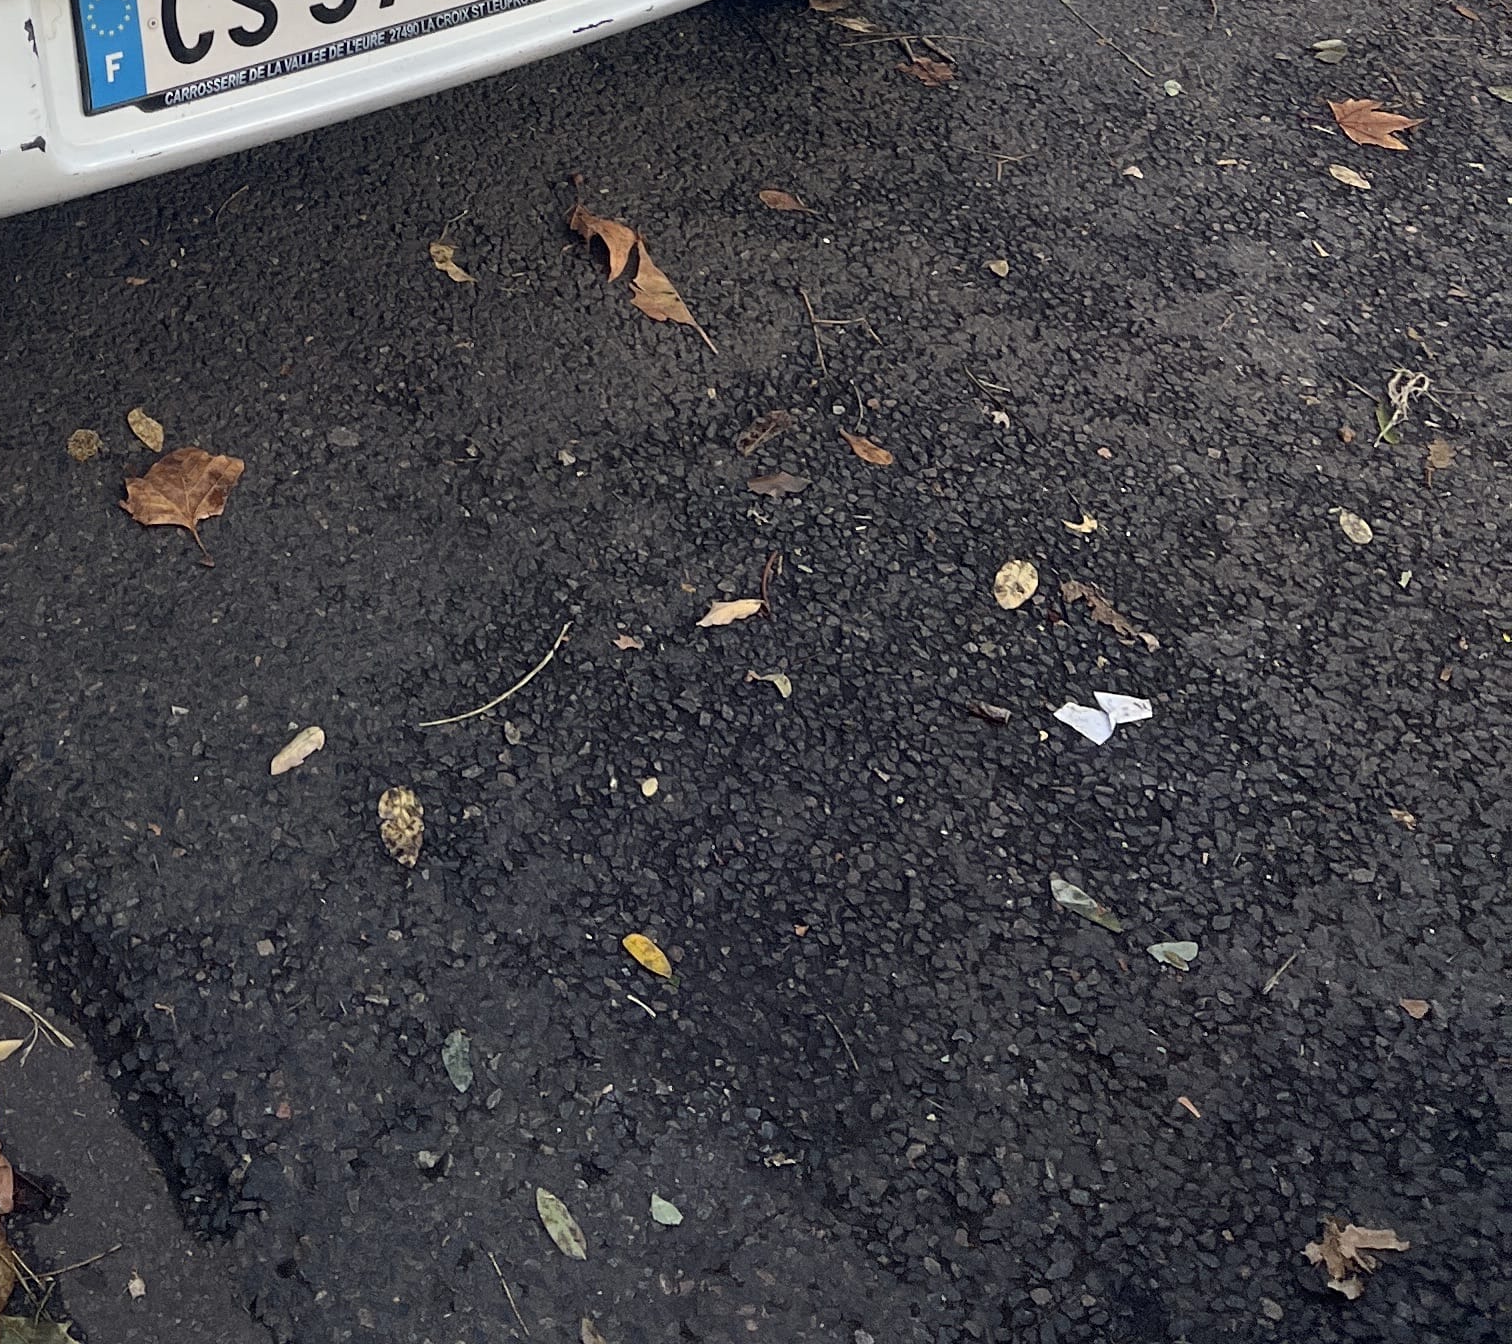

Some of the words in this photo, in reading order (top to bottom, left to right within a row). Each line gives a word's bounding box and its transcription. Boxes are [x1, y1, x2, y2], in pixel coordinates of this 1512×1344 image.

[105, 52, 123, 83] F
[164, 70, 247, 106] CARROSSERIE
[249, 66, 265, 81] DE
[267, 61, 284, 77] LA
[284, 48, 326, 72] VALLEE
[328, 43, 344, 58] DE
[346, 32, 386, 55] L'EURE
[389, 22, 419, 43] 27490
[421, 18, 436, 33] LA
[437, 8, 470, 28] CROIX
[472, 2, 487, 18] ST
